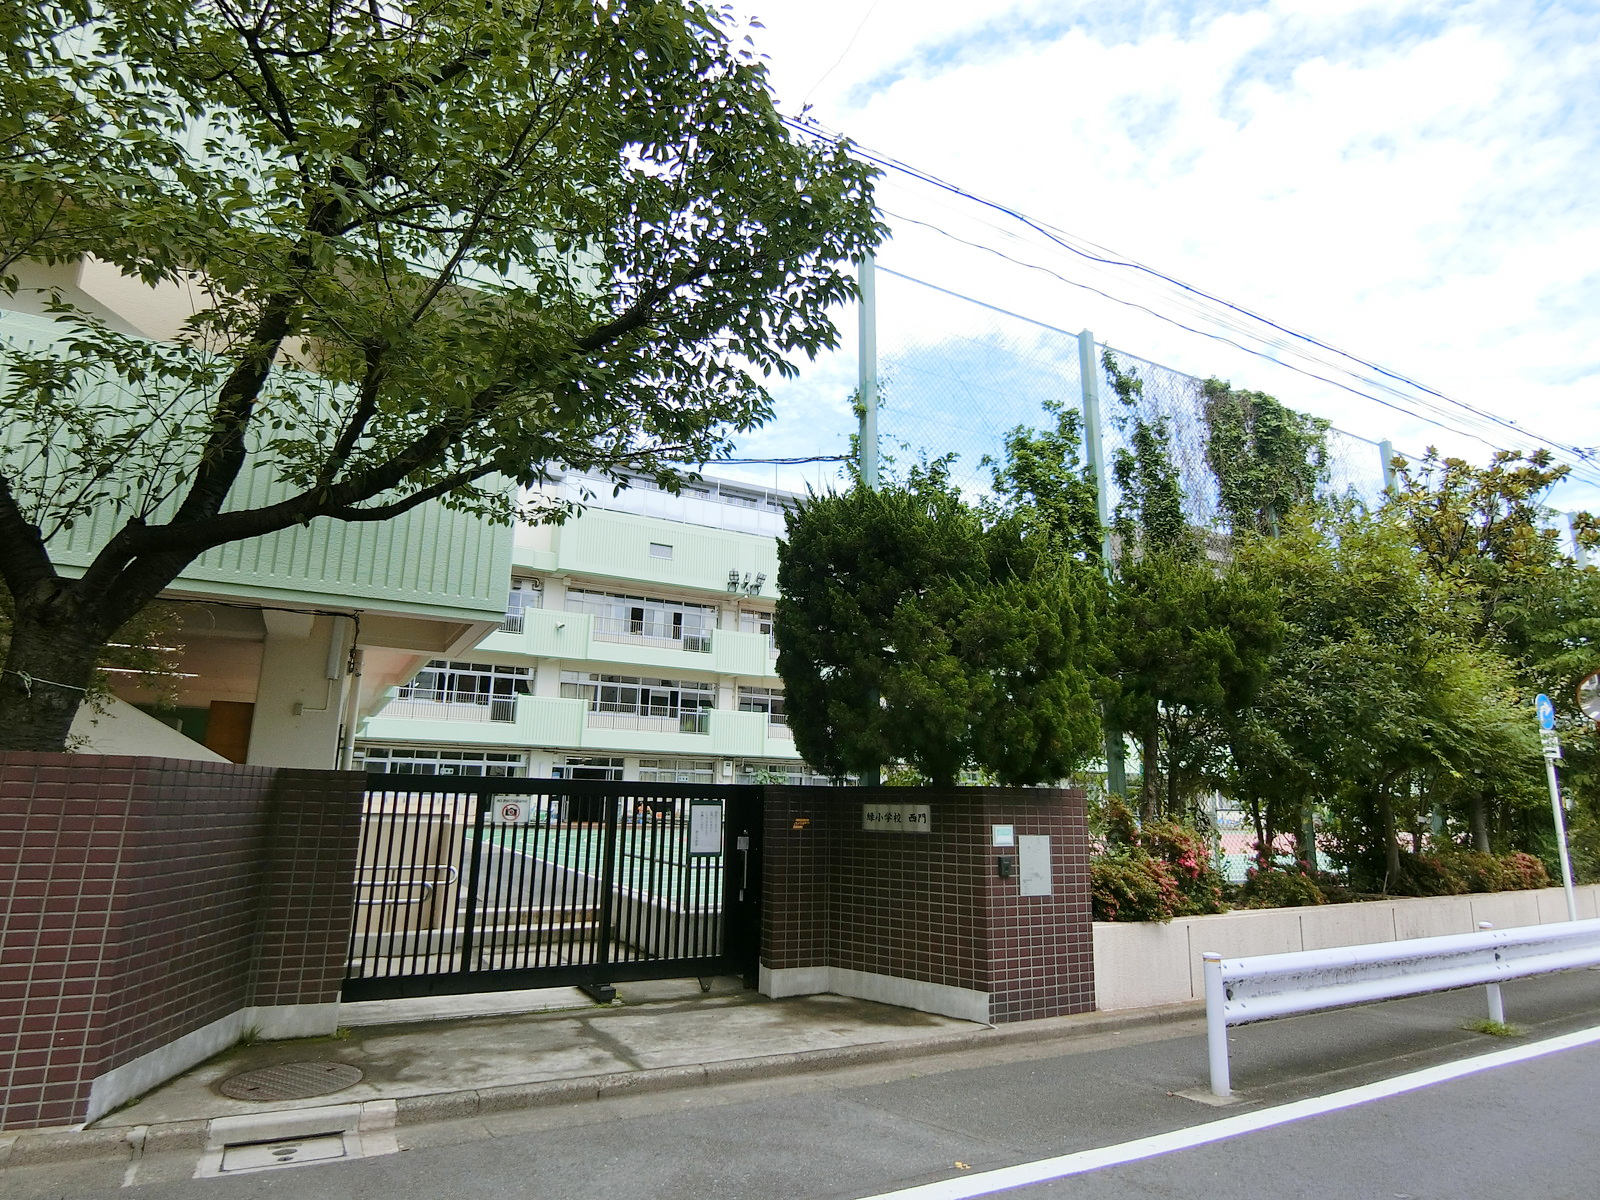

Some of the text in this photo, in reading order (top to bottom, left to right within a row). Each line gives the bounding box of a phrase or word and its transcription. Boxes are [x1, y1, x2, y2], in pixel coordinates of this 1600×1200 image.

[866, 812, 927, 824] 緑小学校 西門
